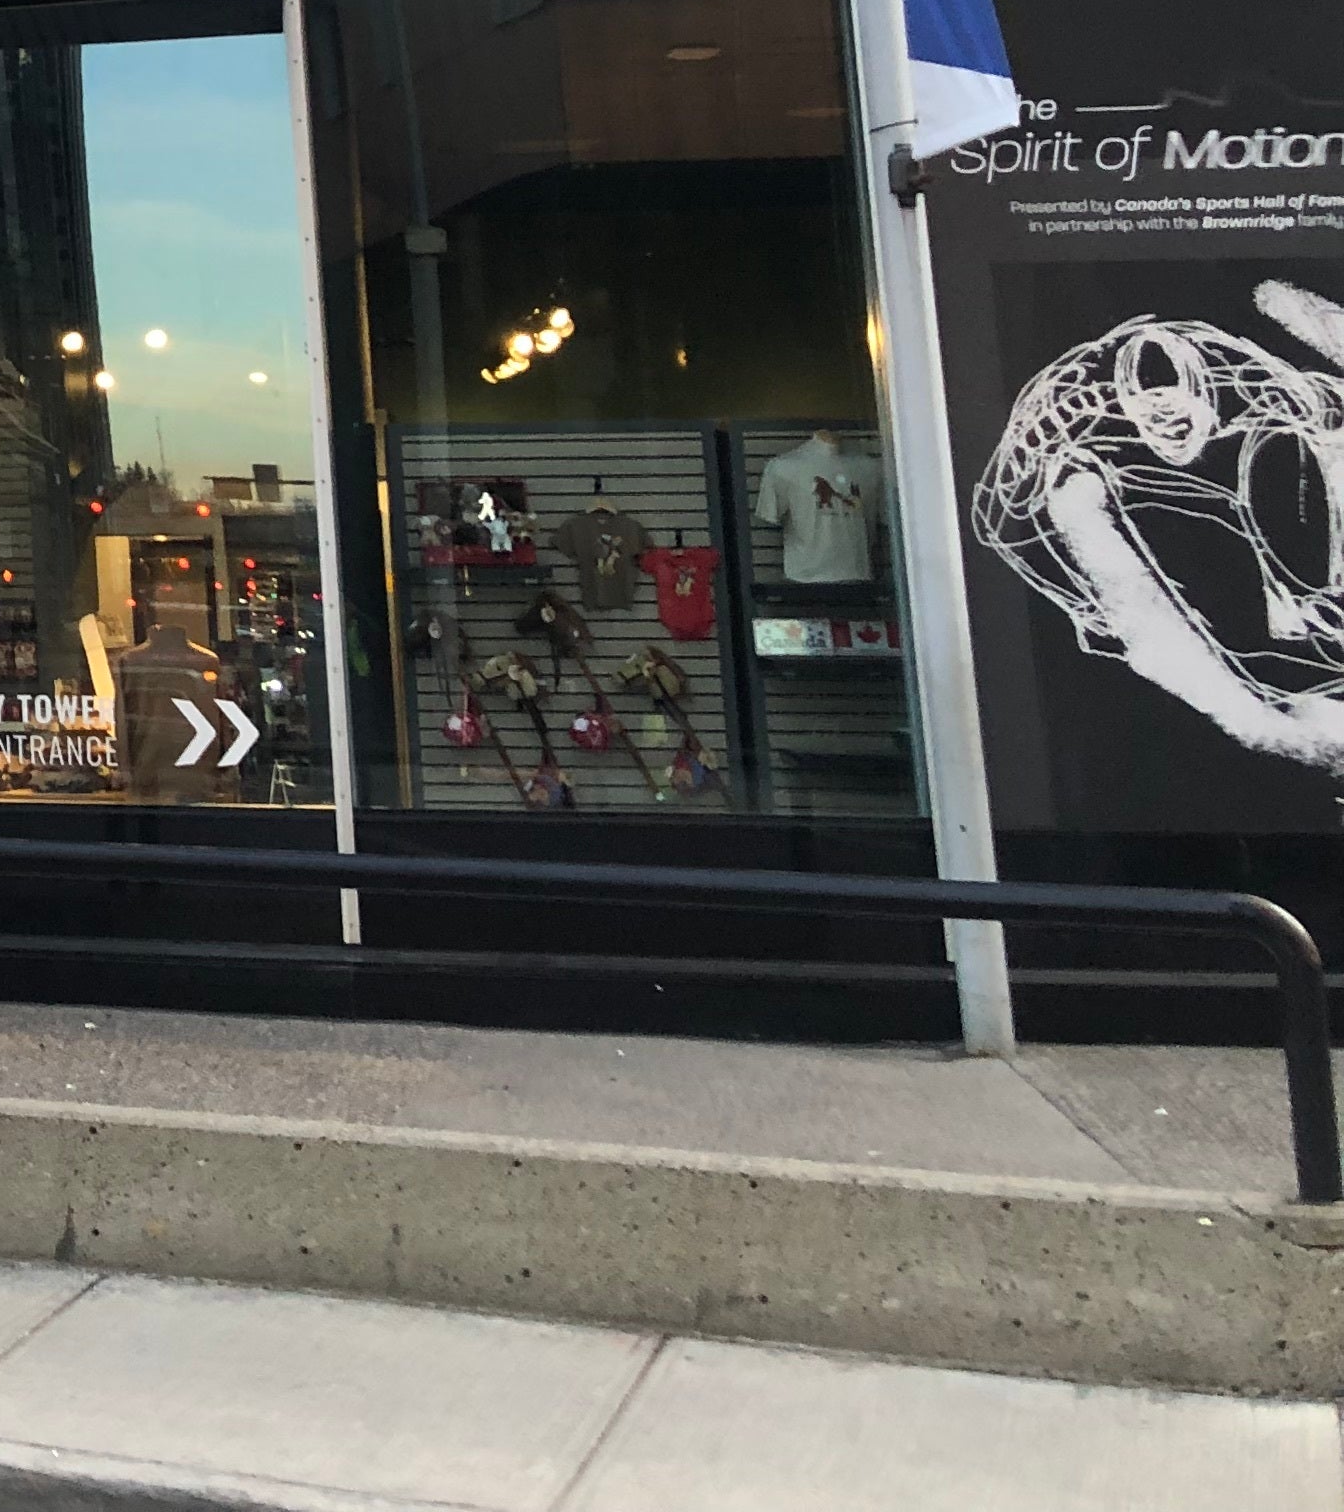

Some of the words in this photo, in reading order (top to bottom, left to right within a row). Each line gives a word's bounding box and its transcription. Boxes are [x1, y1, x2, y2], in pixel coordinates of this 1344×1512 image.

[1018, 94, 1057, 121] he
[951, 131, 1082, 184] Spirit
[1095, 125, 1153, 182] of
[1163, 126, 1344, 170] Motion
[1010, 198, 1087, 214] Presented
[1091, 199, 1111, 216] by
[1114, 196, 1192, 212] Canada's
[1195, 196, 1250, 212] Sports
[1253, 194, 1285, 209] Hall
[1288, 193, 1306, 210] of
[1308, 193, 1344, 209] Fam
[1029, 220, 1043, 233] in
[1046, 217, 1133, 235] partnership
[1136, 217, 1170, 231] with
[1173, 216, 1198, 230] the
[1202, 215, 1294, 233] Brownridge
[16, 694, 116, 725] TOWER
